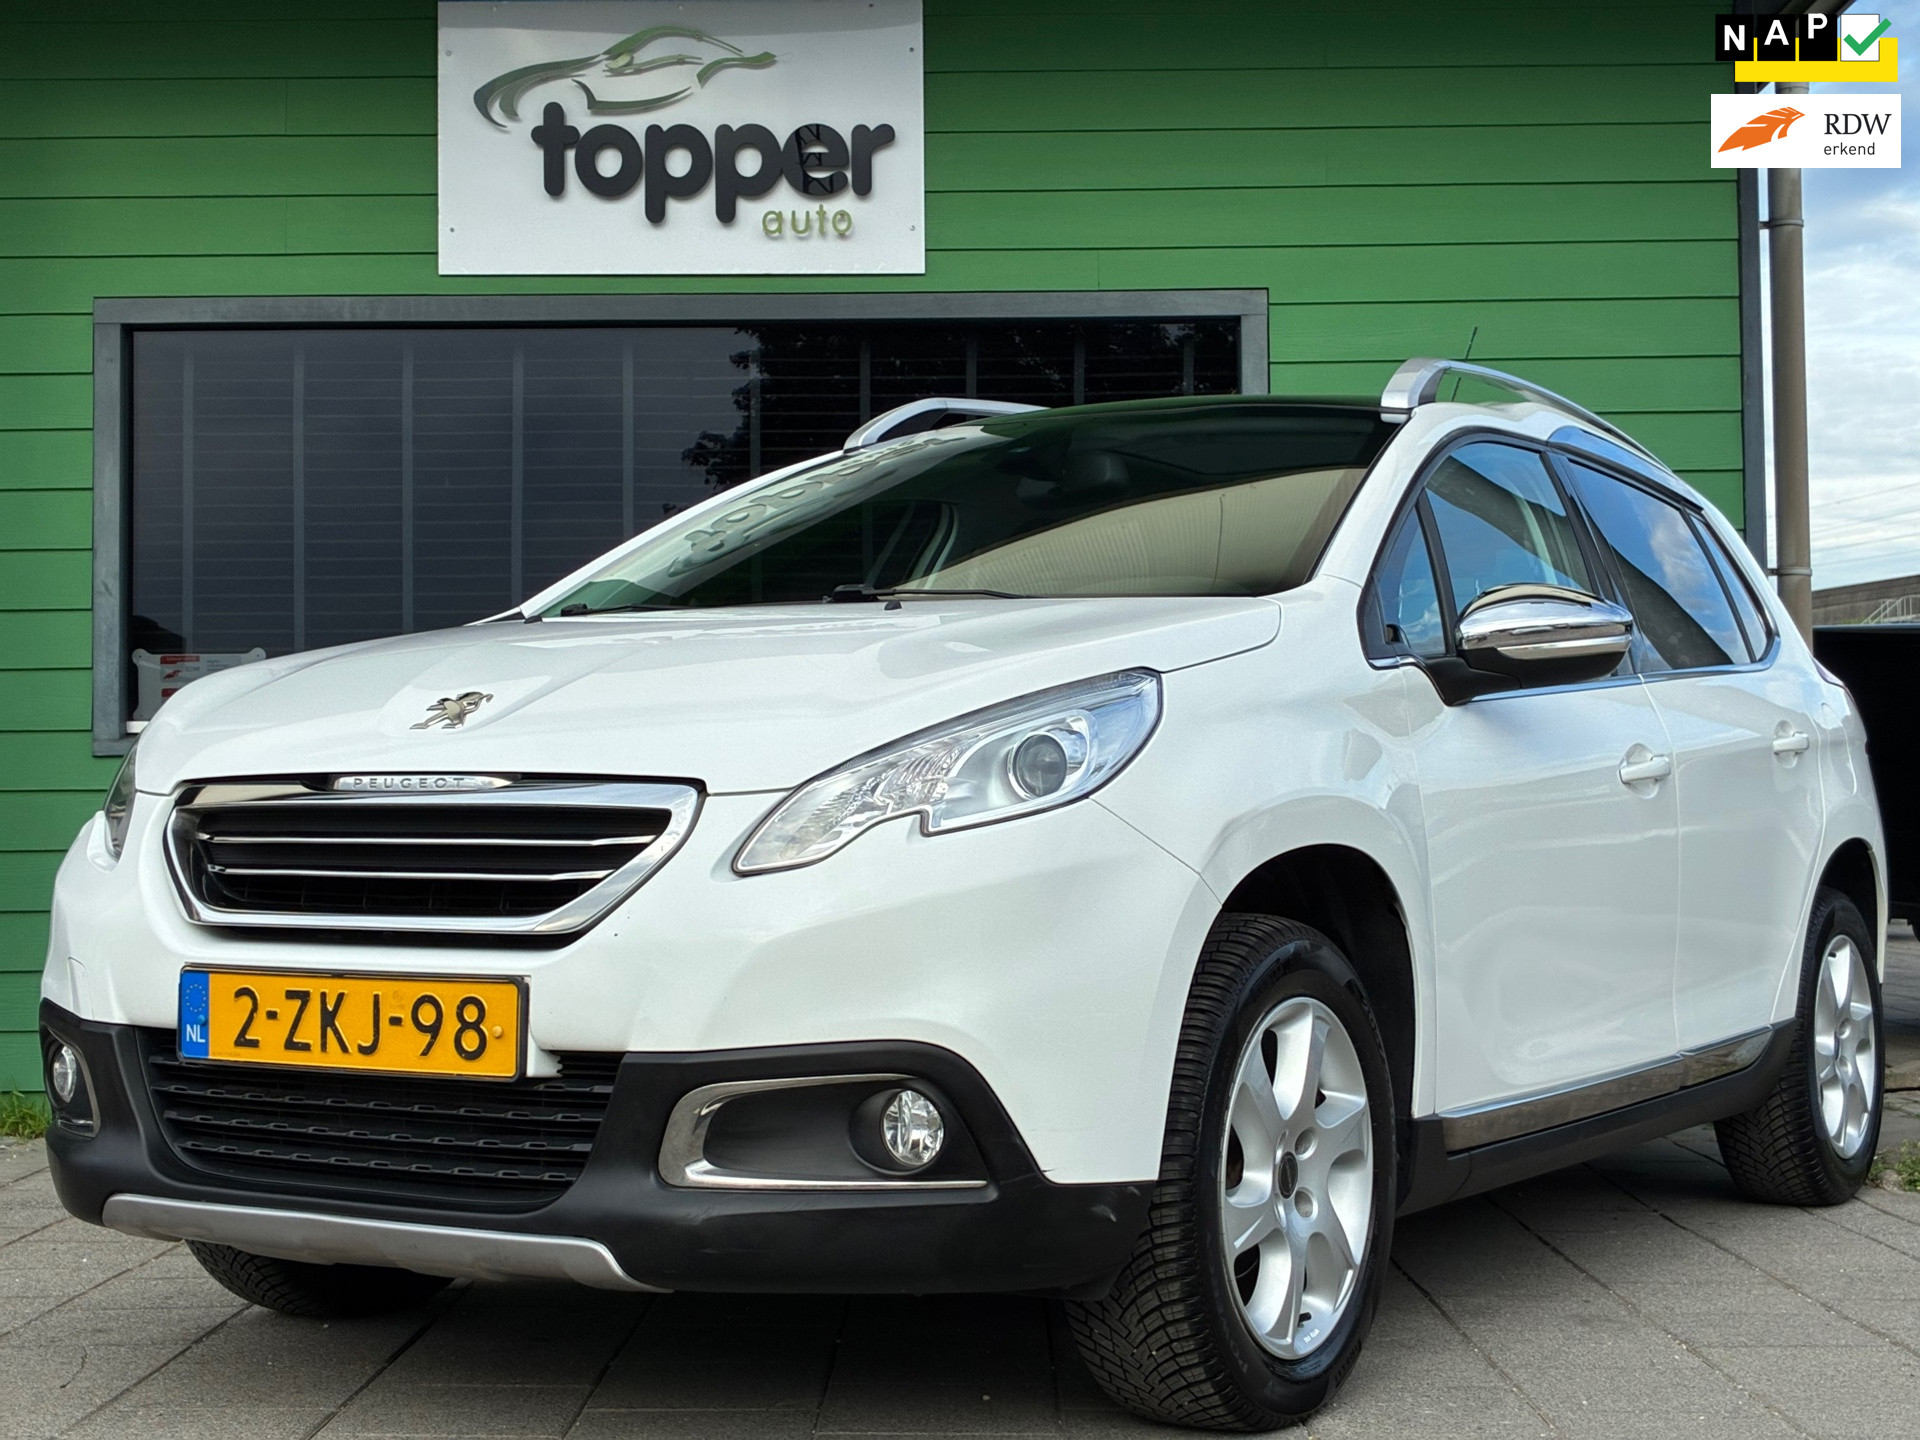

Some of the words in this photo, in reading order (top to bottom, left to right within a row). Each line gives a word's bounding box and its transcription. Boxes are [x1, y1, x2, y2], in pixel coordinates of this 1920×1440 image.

[531, 101, 896, 224] topper
[762, 204, 853, 237] auto
[353, 777, 465, 789] PEUGEOT
[185, 1023, 206, 1043] NL
[233, 985, 489, 1061] 2-ZKJ-98
